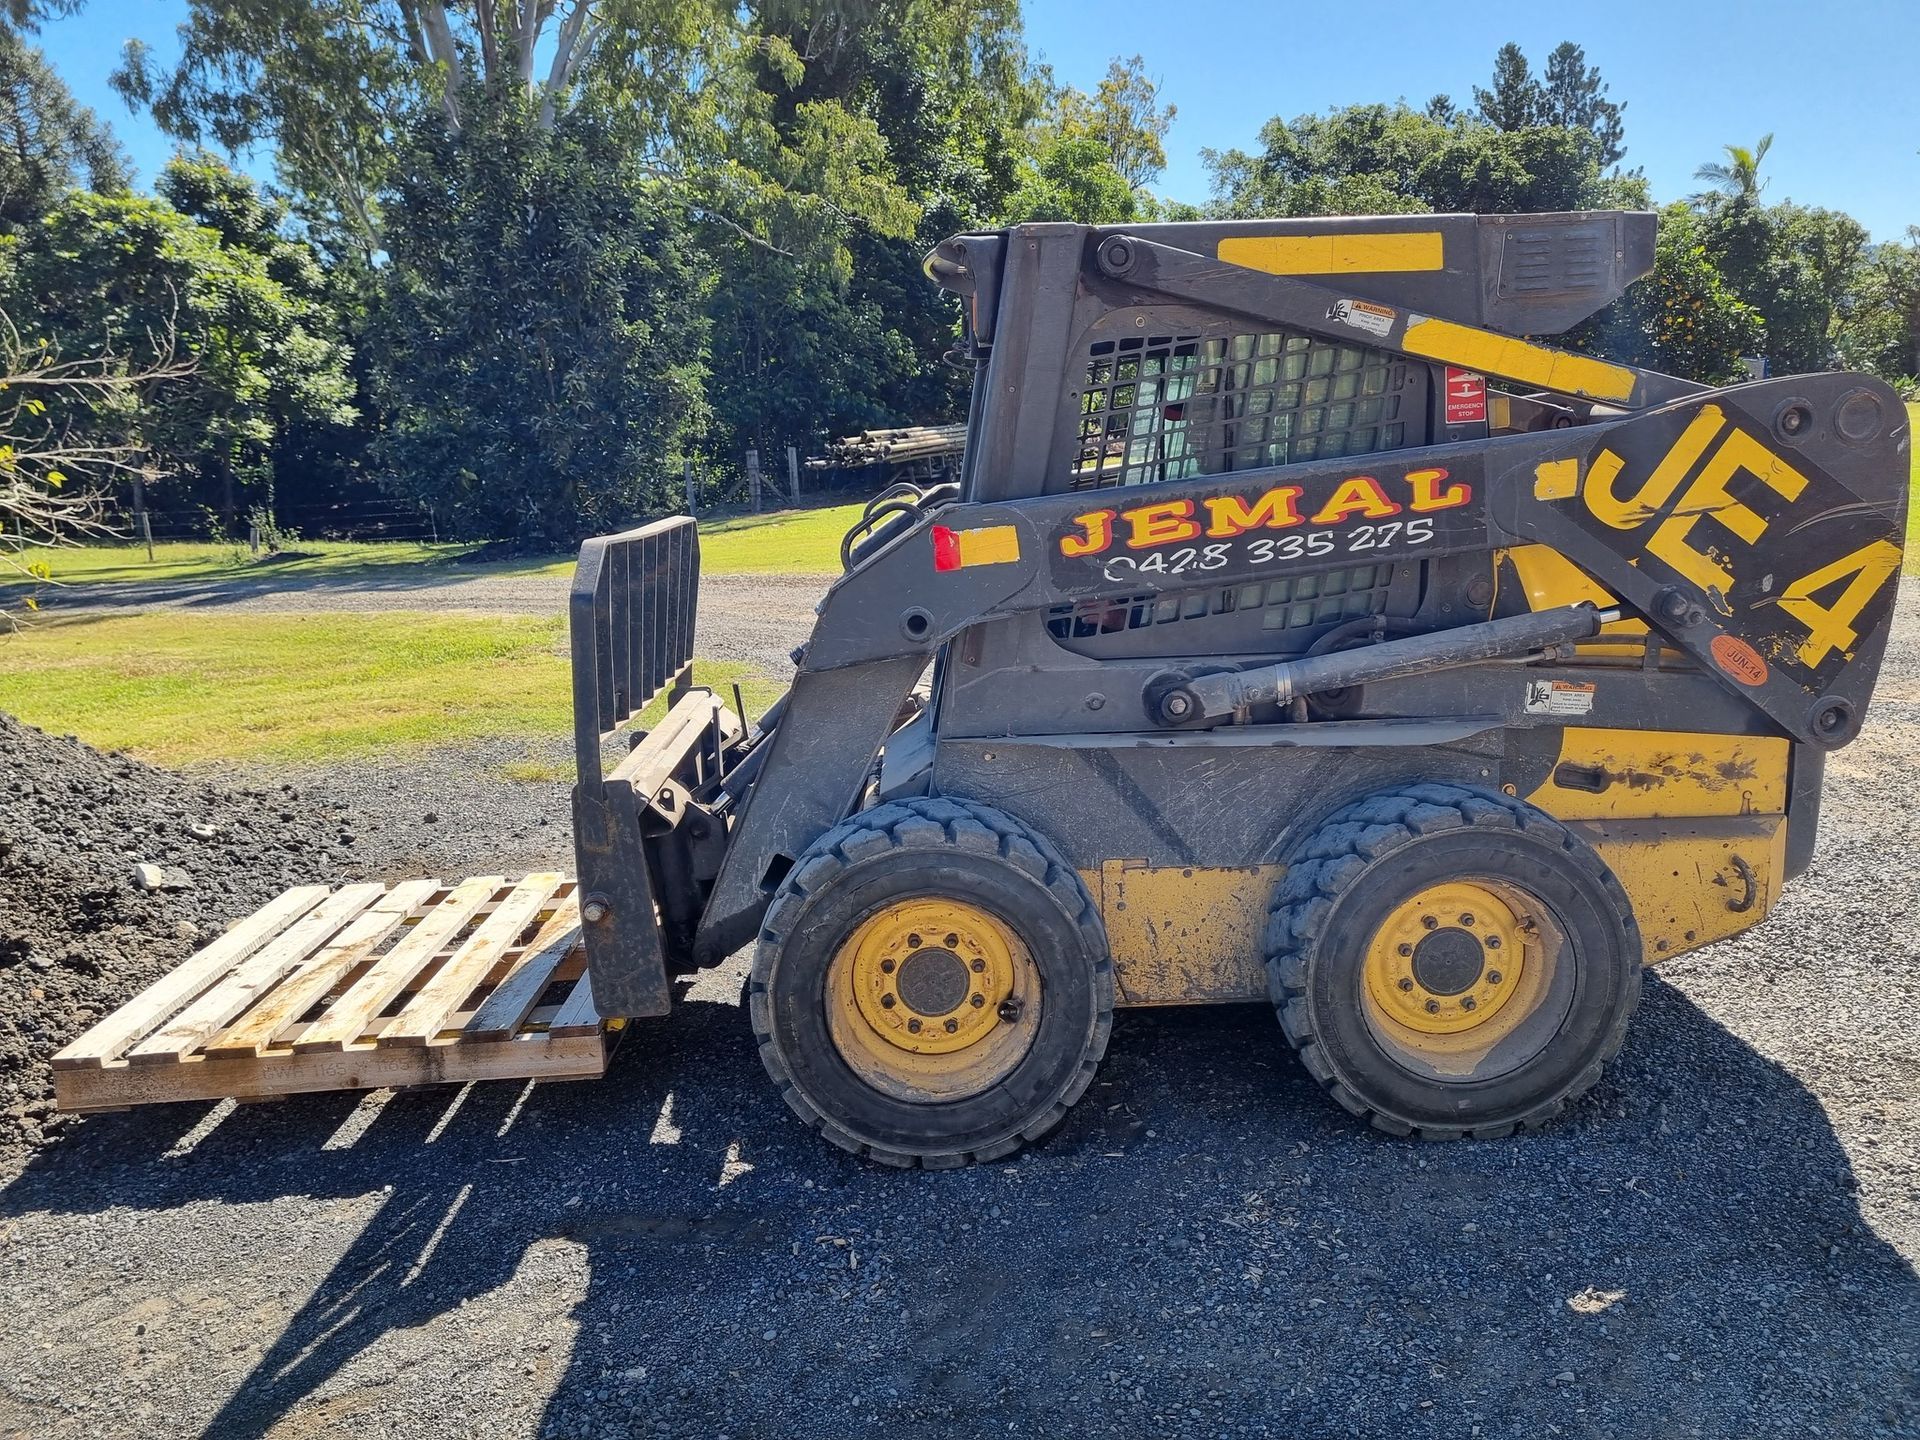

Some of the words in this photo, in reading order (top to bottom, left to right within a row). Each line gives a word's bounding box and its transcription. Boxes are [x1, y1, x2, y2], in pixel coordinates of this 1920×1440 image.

[1363, 305, 1392, 316] WARNING
[1448, 402, 1483, 410] EMERGENCY
[1060, 467, 1471, 557] JEMAL
[1104, 542, 1232, 582] 0428
[1247, 530, 1335, 563] 335
[1347, 518, 1434, 551] 275
[1727, 650, 1761, 679] JUN-14
[314, 1062, 347, 1077] 1165
